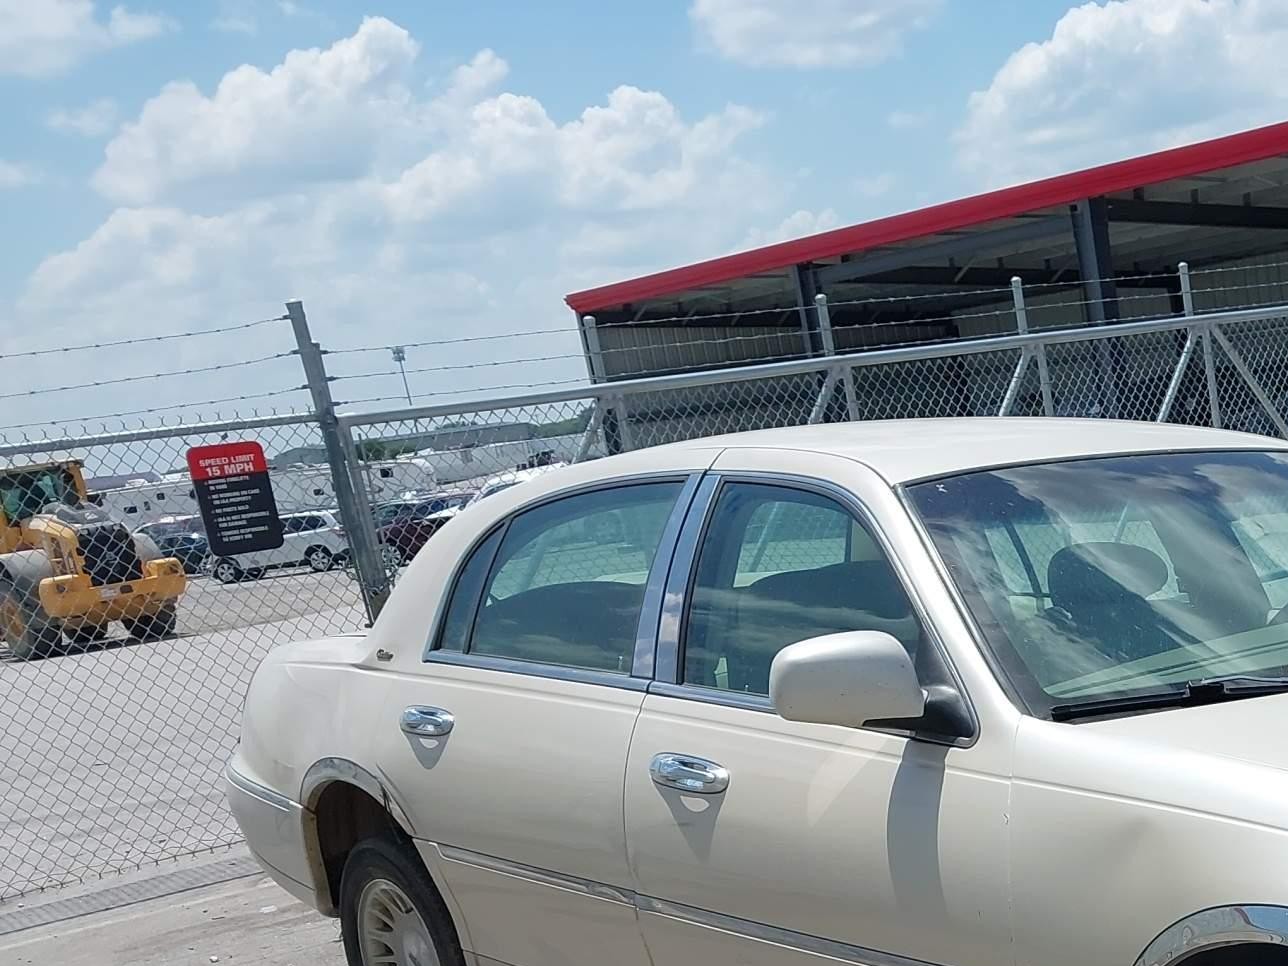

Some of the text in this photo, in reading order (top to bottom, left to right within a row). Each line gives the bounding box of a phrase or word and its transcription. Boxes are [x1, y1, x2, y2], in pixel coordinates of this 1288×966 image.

[199, 454, 255, 467] SPEED LIMIT
[206, 462, 254, 476] 15 MPH
